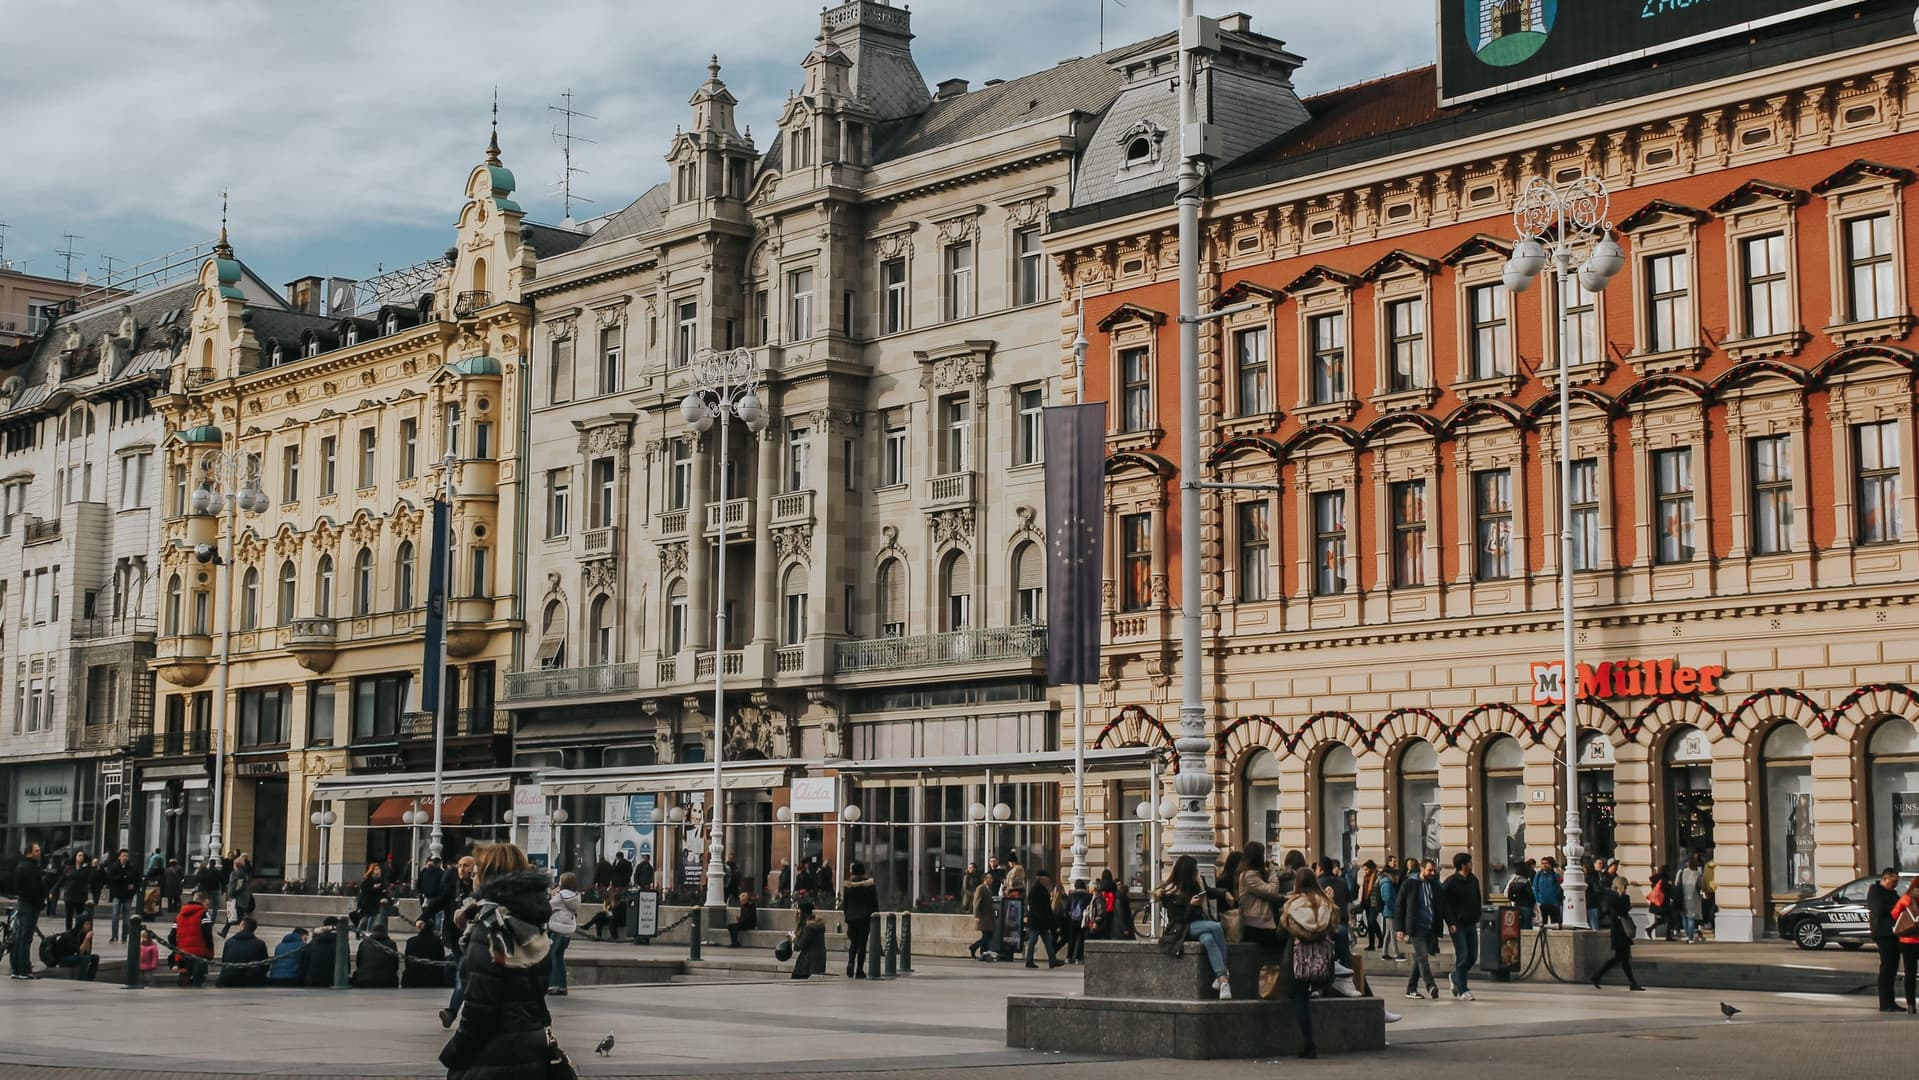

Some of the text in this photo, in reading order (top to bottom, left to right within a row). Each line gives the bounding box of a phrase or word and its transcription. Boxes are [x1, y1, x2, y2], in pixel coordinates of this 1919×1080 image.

[1539, 659, 1722, 698] M Müller
[1828, 912, 1861, 923] KLEMM
